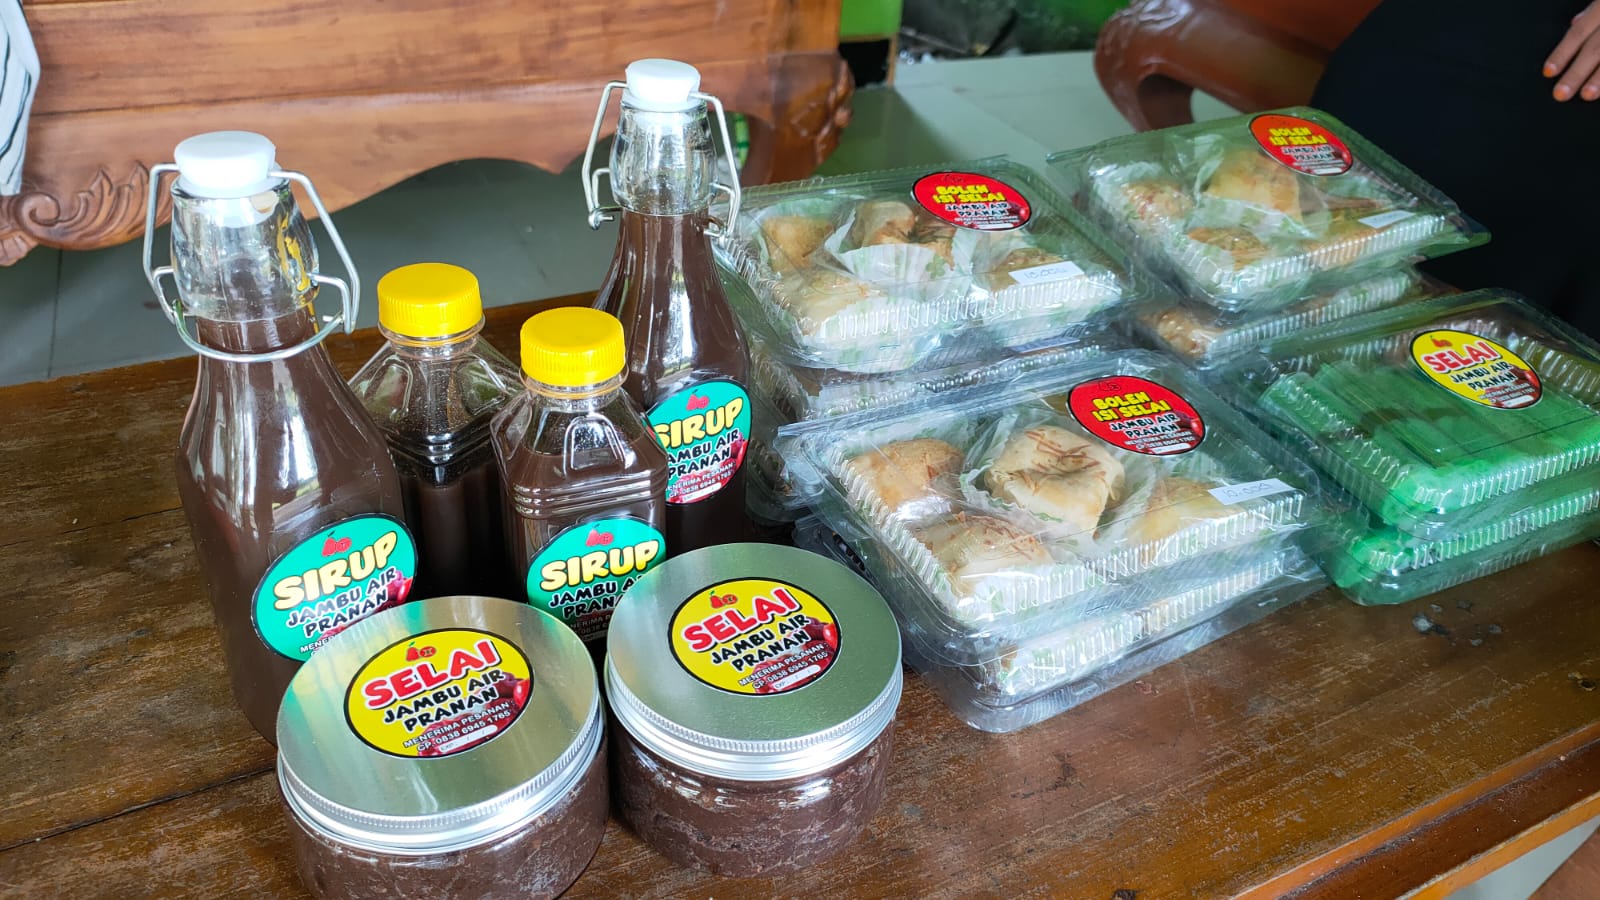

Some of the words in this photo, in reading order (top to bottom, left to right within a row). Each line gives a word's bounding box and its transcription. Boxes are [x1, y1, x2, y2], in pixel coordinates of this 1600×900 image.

[1289, 135, 1328, 145] SELAI
[933, 194, 956, 203] ISI
[958, 192, 1006, 202] SELAI
[935, 185, 989, 195] BOLEN
[1423, 341, 1501, 373] SELAI
[1451, 367, 1491, 383] JAMBU
[1491, 361, 1512, 373] AIR
[1468, 372, 1517, 390] PRANAN
[1092, 392, 1151, 410] BOLEN
[1092, 409, 1119, 422] ISI
[1119, 400, 1172, 418] SELAI
[653, 397, 743, 448] SIRUP
[1111, 419, 1154, 431] JAMBU
[1159, 414, 1179, 423] AIR
[1126, 424, 1178, 438] PRANAN
[668, 443, 711, 464] AMBU
[716, 429, 739, 449] AIR
[668, 447, 730, 478] PRANAN
[666, 477, 701, 491] ENERIMA
[274, 531, 397, 611] SIRUP
[540, 540, 659, 591] SIRUP
[288, 587, 361, 626] JAMBU
[367, 568, 396, 594] AIR
[550, 582, 616, 606] JAMBU
[563, 595, 622, 618] PRAN
[305, 590, 387, 636] PRANAN
[683, 588, 801, 652] SELAI
[711, 629, 775, 664] JAMBU
[779, 615, 810, 634] AIR
[732, 630, 809, 671] PRANAN
[364, 640, 501, 710] SELAI
[738, 662, 784, 687] MENERIMA
[785, 644, 824, 665] PESANAN
[768, 670, 787, 683] 0838
[789, 661, 808, 673] 6945
[809, 652, 828, 664] 1765
[384, 686, 461, 723] JAMBU
[468, 670, 503, 691] AIR
[404, 688, 497, 731] PRANAN
[403, 721, 459, 748] MENERIMA
[461, 702, 510, 725] PESANAN
[417, 738, 435, 752] CP.
[435, 730, 461, 745] 0838
[462, 720, 486, 734] 6945
[488, 710, 511, 725] 1765
